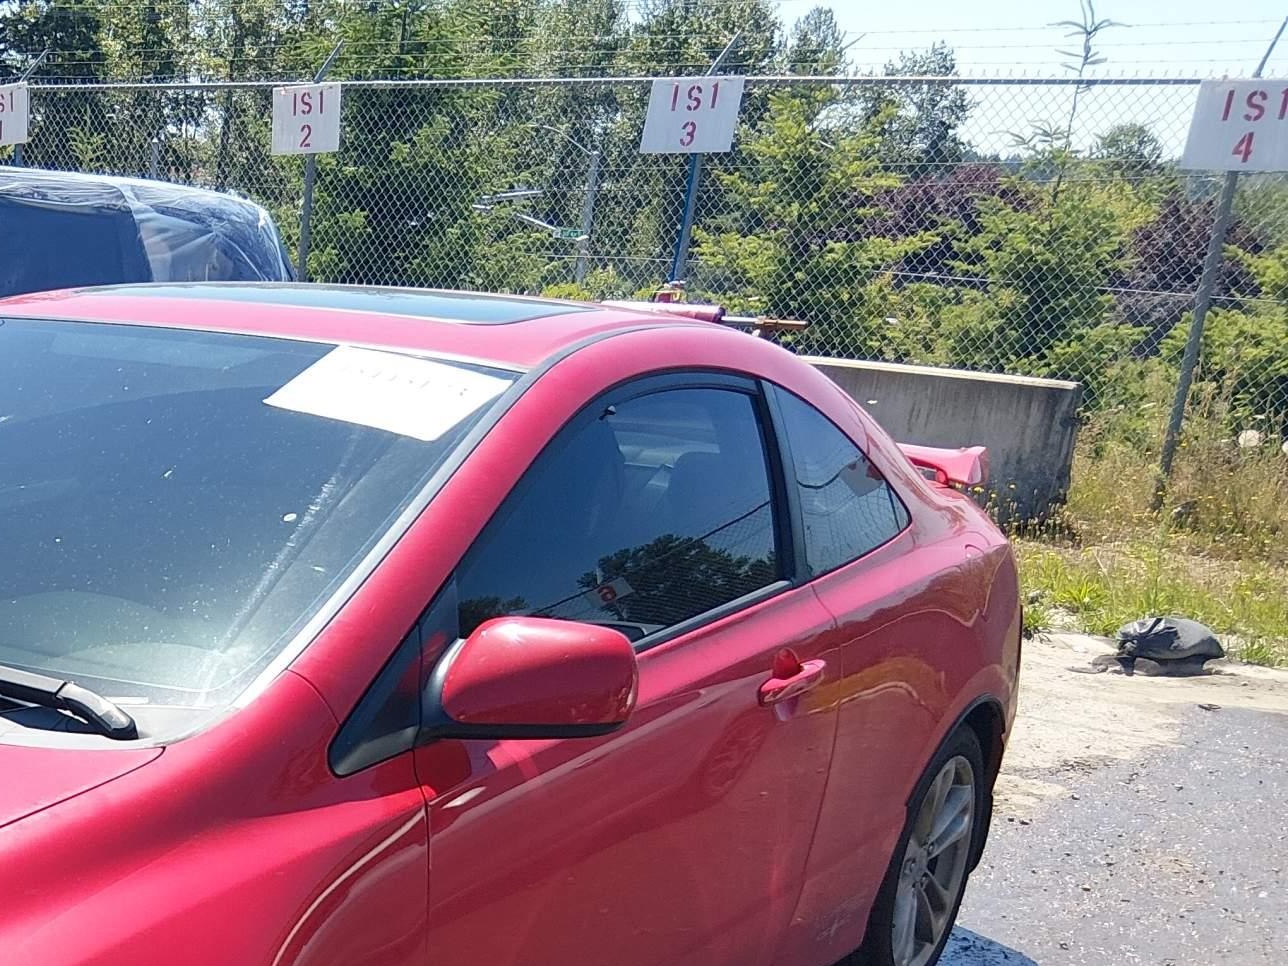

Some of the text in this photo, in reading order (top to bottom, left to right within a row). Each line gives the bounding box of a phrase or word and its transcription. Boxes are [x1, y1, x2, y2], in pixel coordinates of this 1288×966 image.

[299, 124, 312, 148] 2
[679, 121, 697, 147] 3
[1231, 131, 1255, 163] 4
